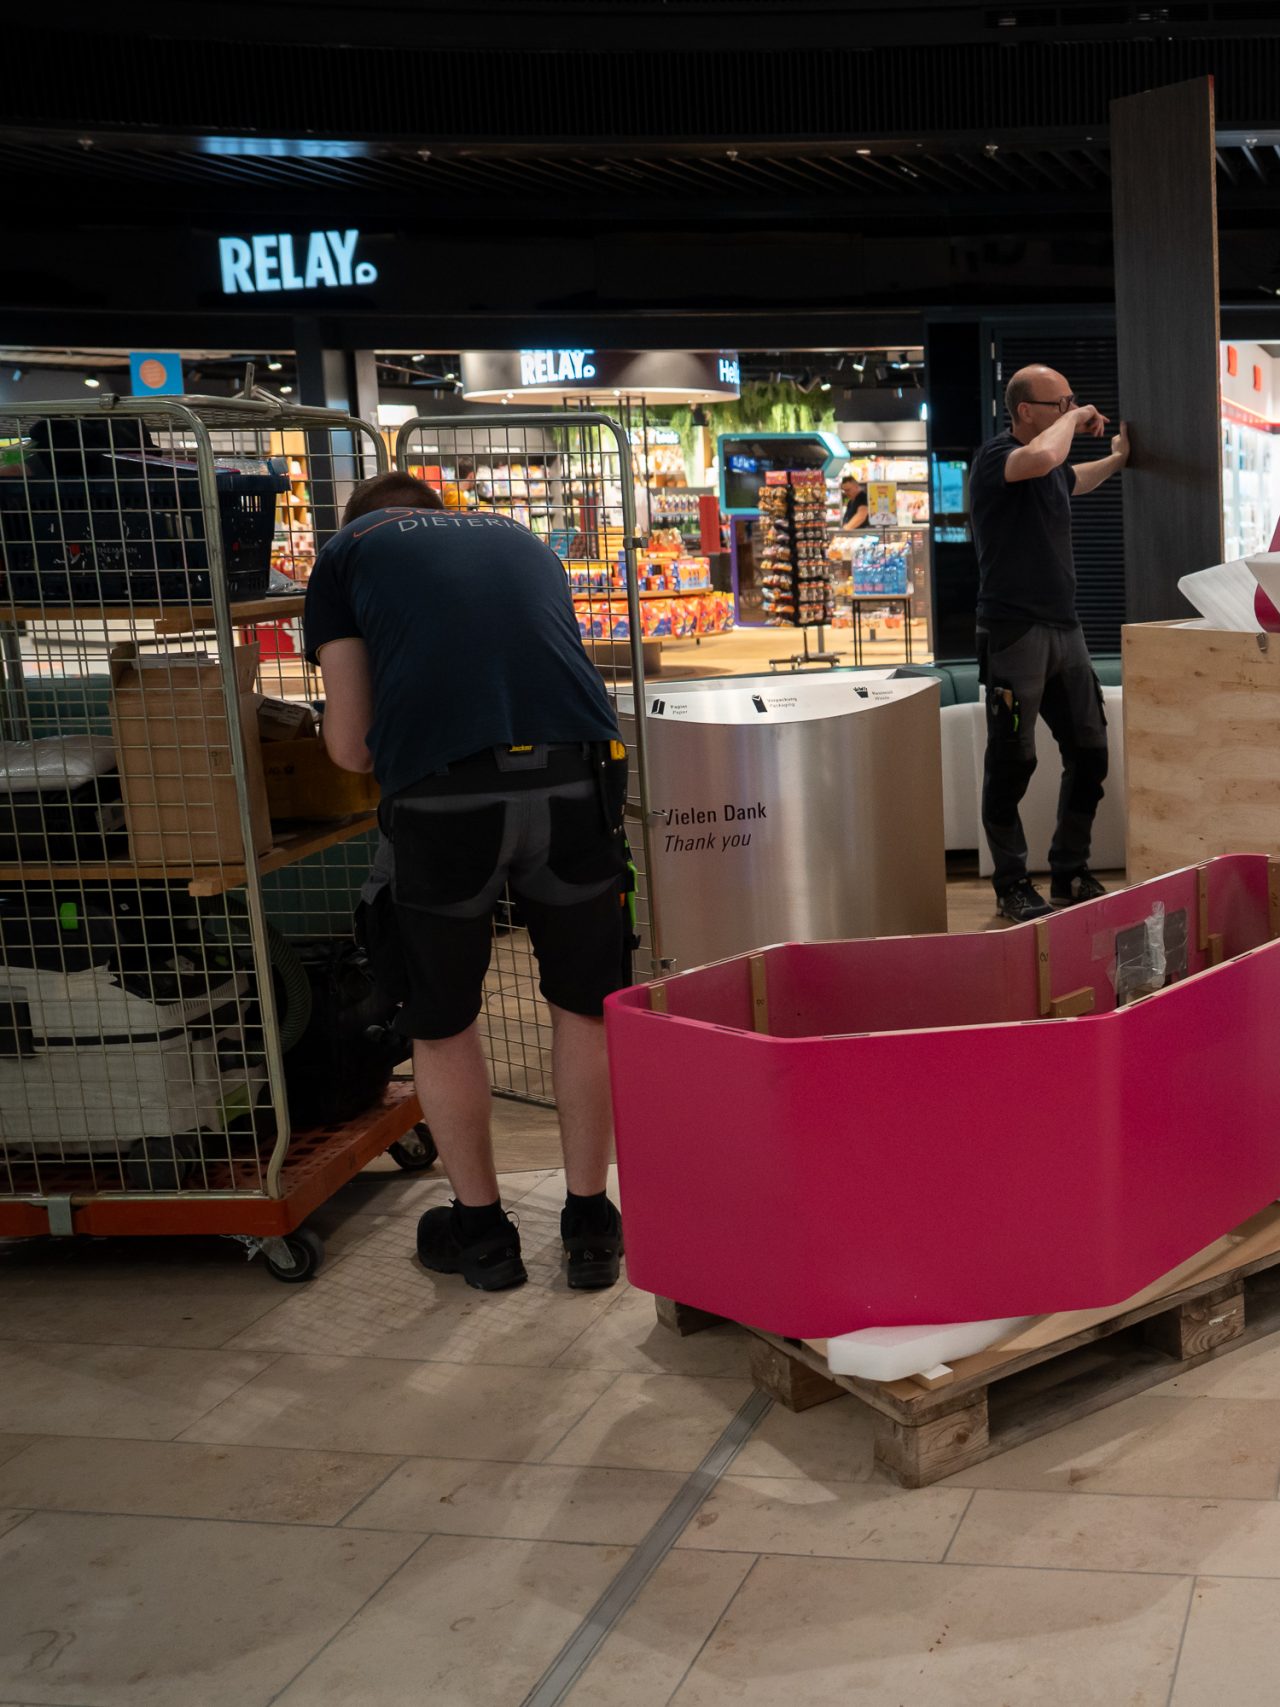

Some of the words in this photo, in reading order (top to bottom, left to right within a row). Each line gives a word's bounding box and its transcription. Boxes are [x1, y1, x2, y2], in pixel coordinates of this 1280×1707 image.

[218, 229, 359, 294] RELAY
[520, 353, 585, 385] RELAY
[662, 807, 717, 826] Vielen
[724, 802, 767, 821] Dank
[665, 832, 716, 852] Thank
[721, 833, 751, 852] you
